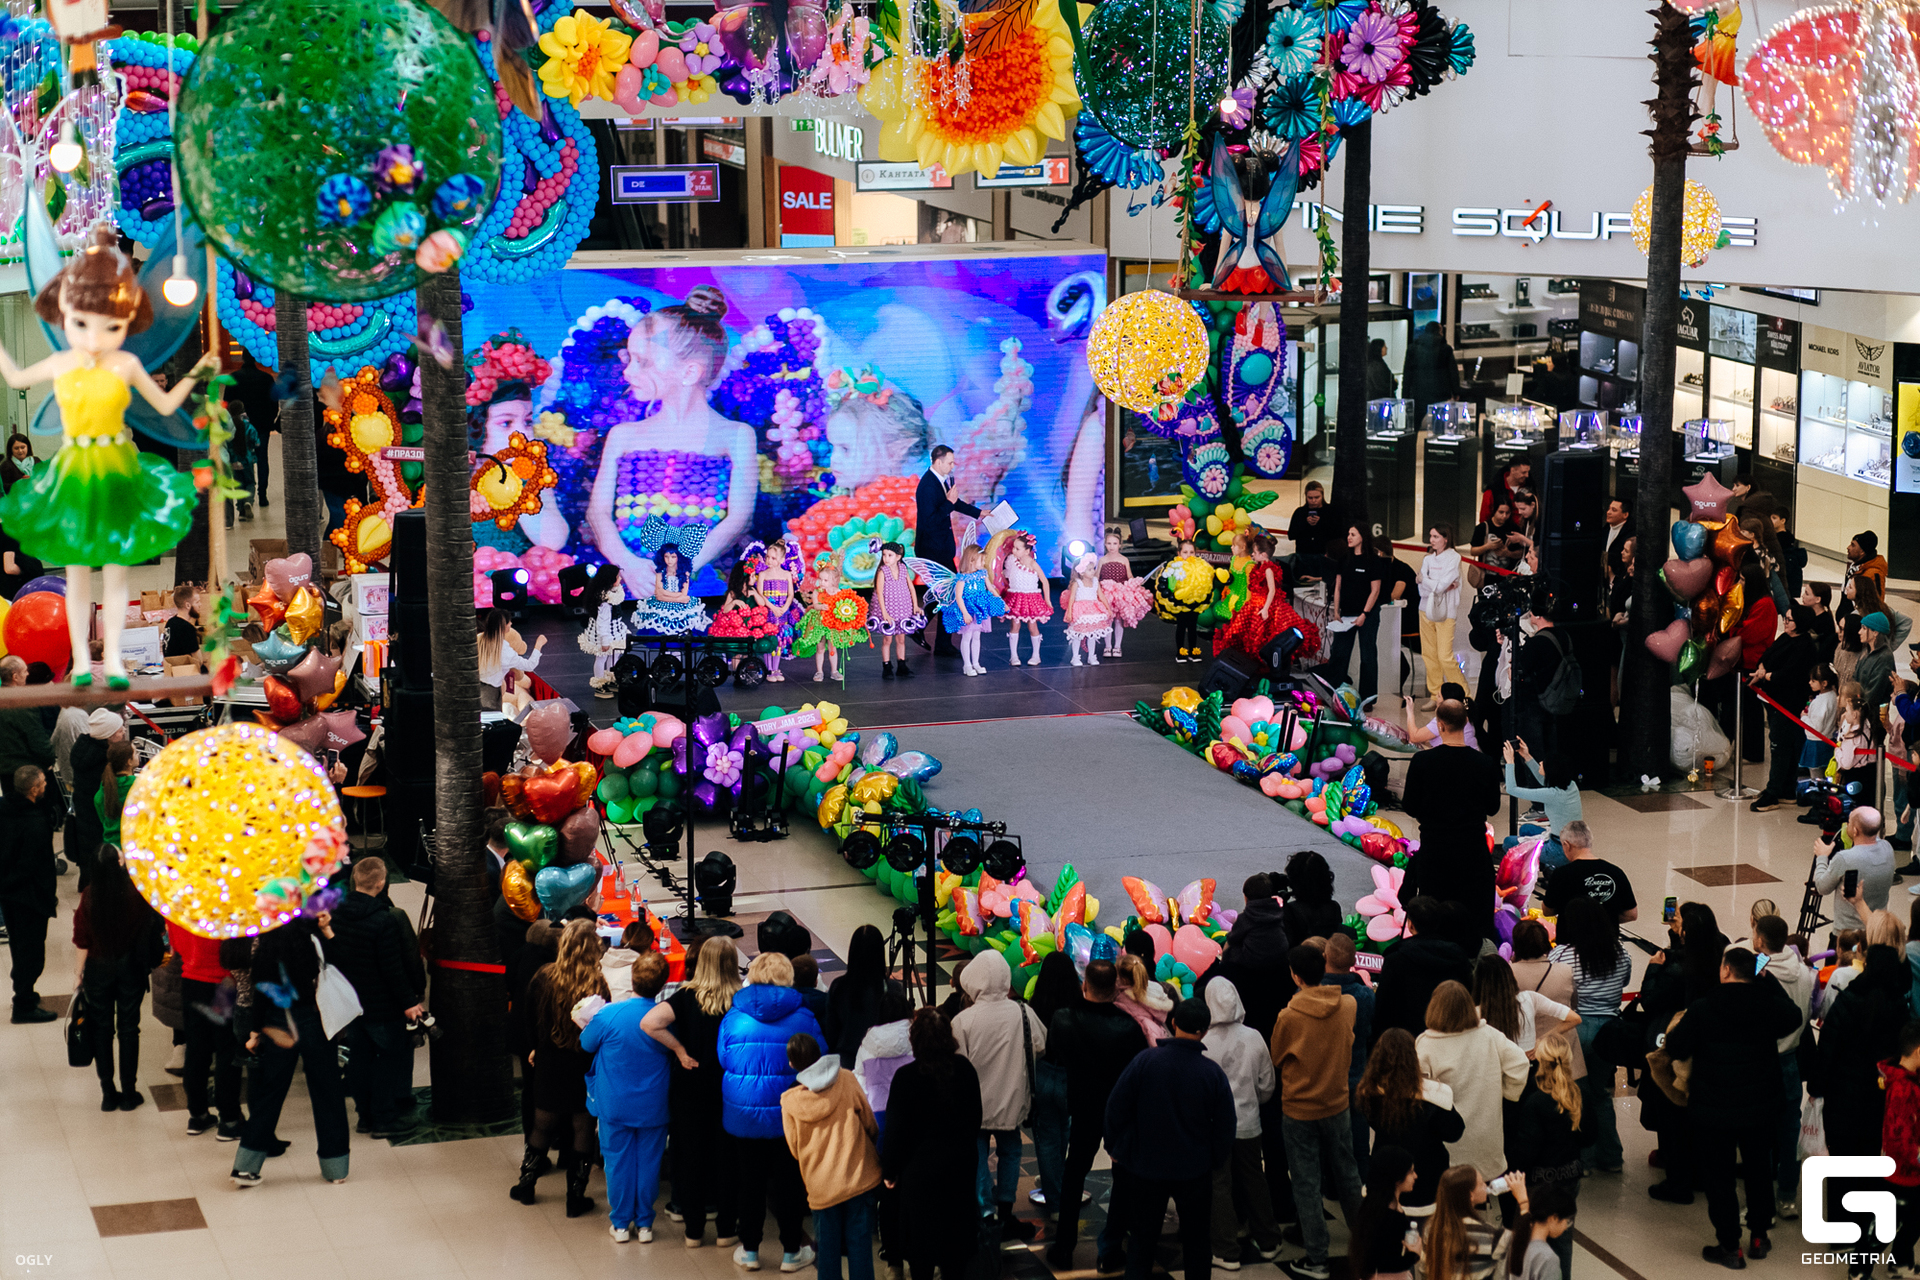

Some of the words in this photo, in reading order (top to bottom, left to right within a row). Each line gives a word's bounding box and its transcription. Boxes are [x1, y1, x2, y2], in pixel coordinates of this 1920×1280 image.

[814, 118, 863, 162] BULMER
[699, 175, 707, 185] 2
[783, 191, 832, 210] SALE
[1677, 323, 1699, 341] JAGUAR
[1808, 343, 1827, 353] MICHAEL
[1827, 347, 1840, 356] KORS
[1857, 361, 1881, 374] AVIATOR
[1371, 523, 1383, 537] 6
